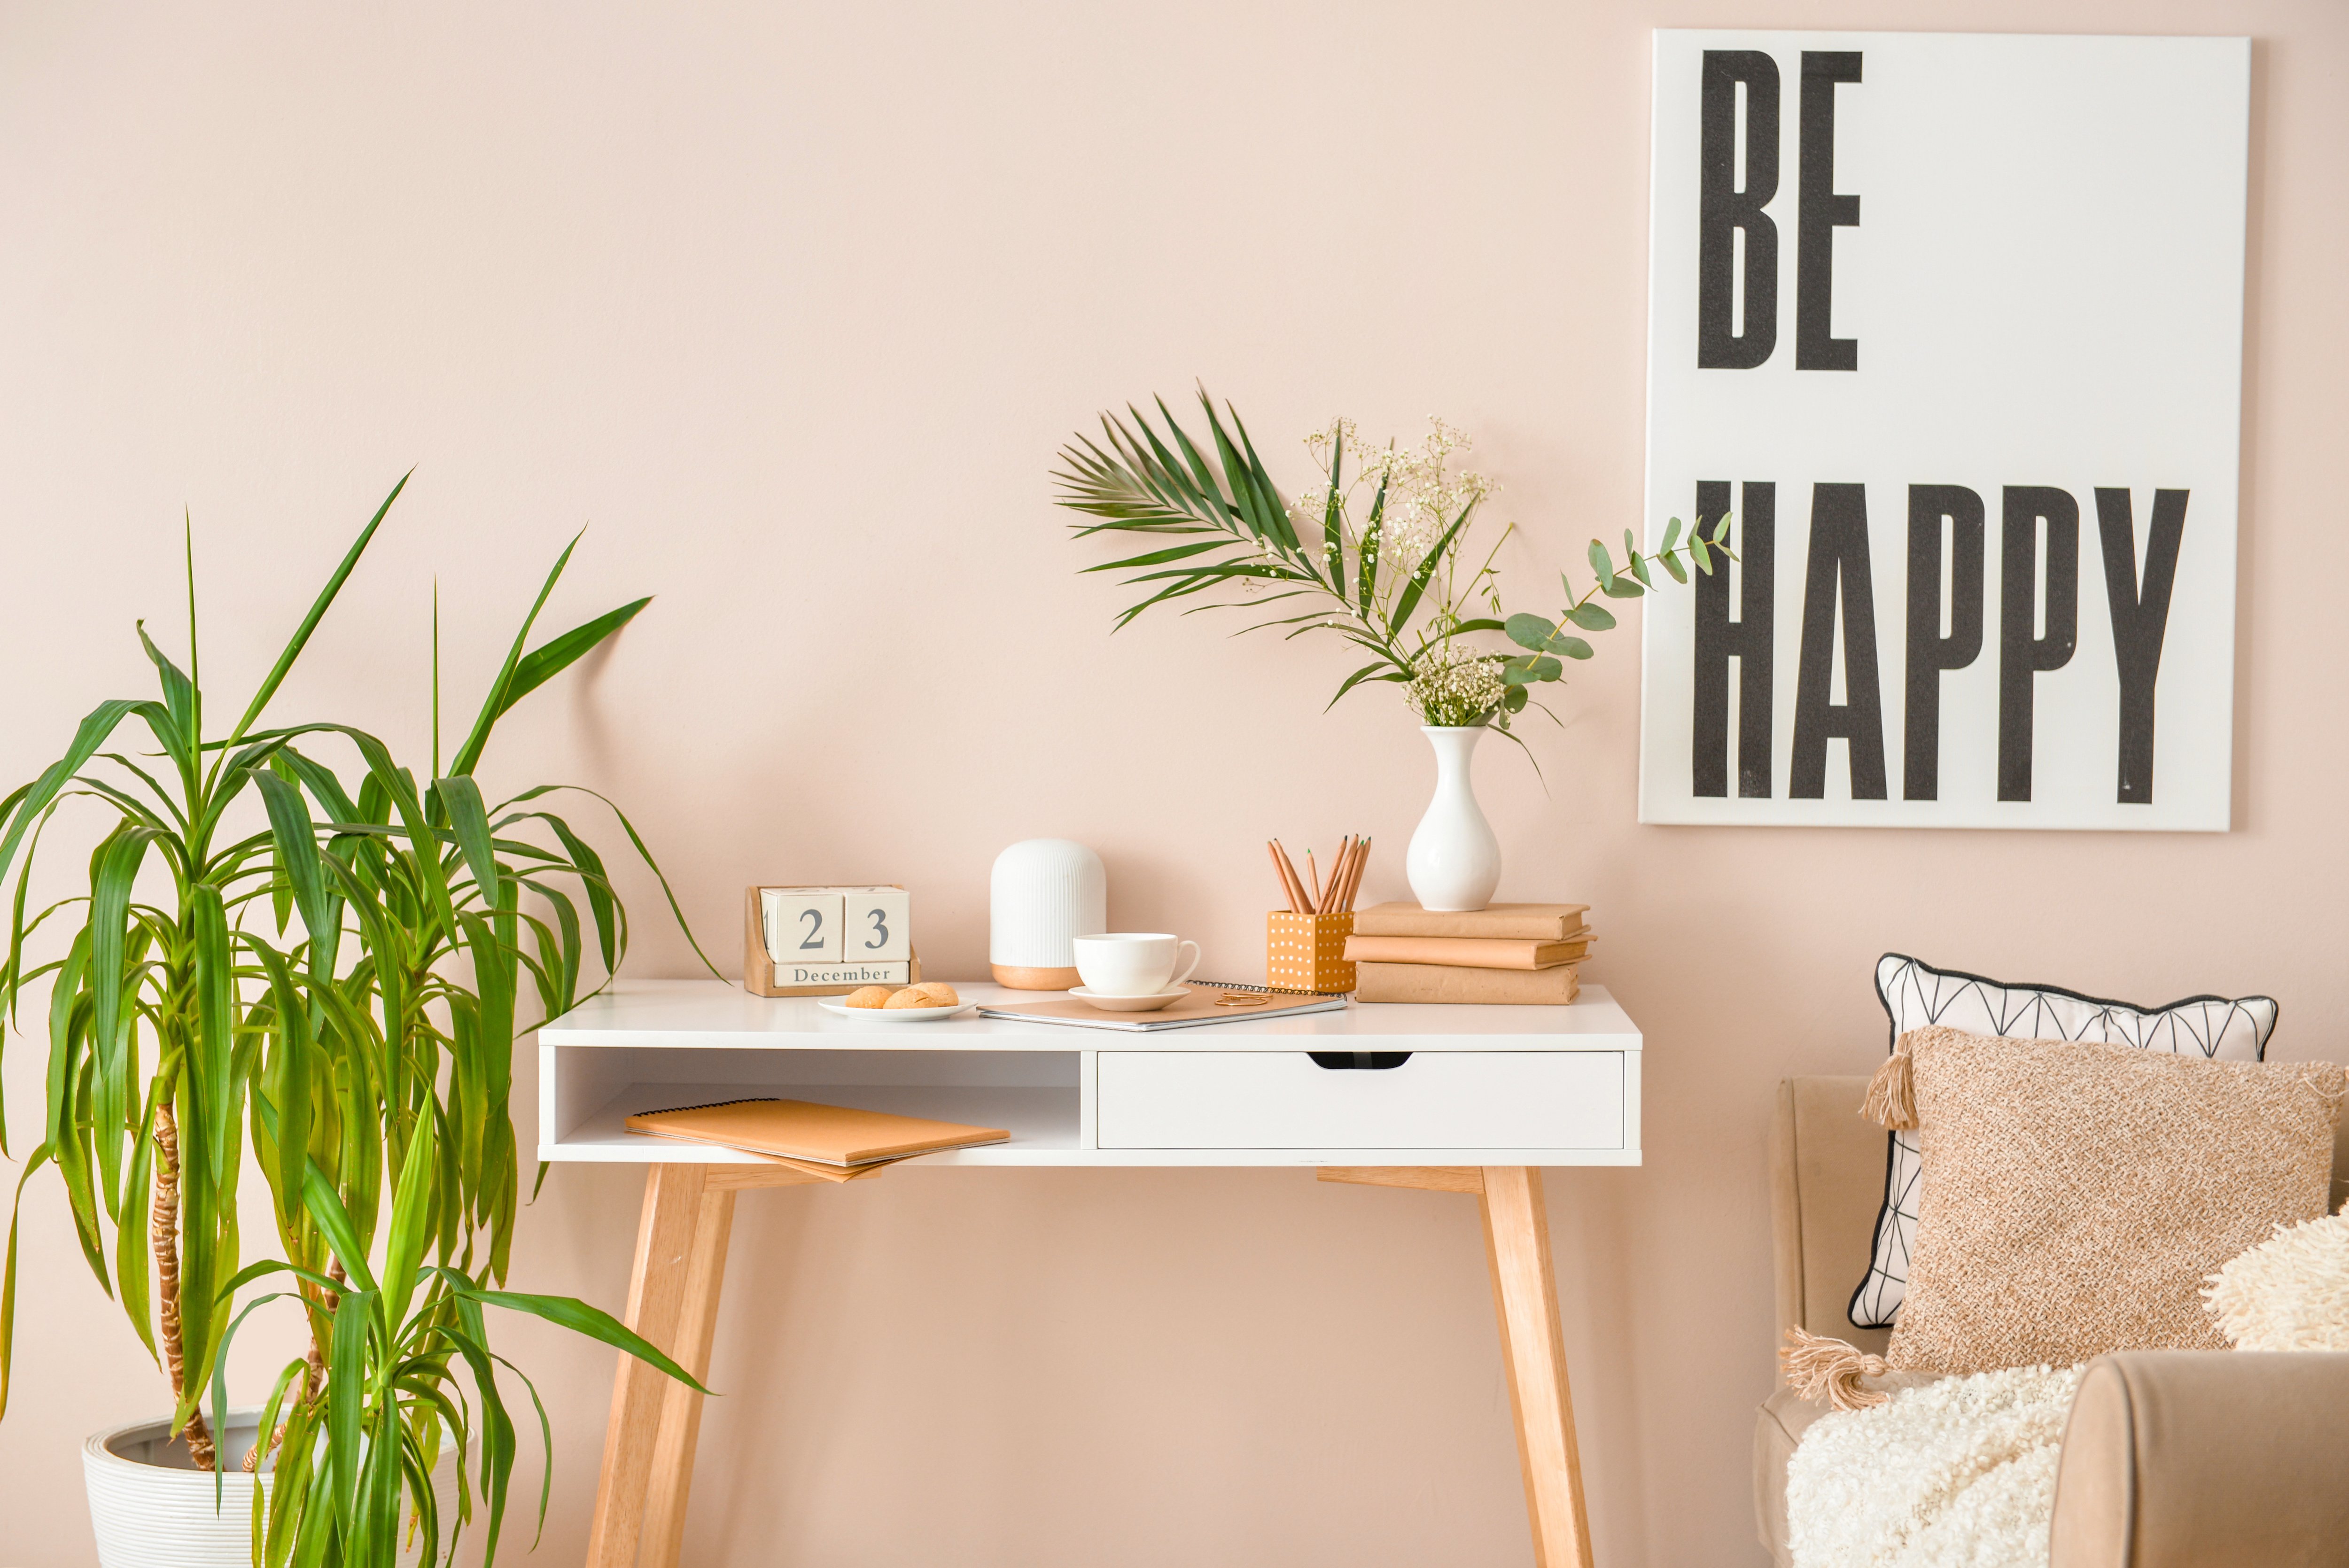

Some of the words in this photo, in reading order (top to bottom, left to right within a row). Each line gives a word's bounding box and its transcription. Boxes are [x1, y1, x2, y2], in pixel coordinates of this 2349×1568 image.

[1697, 49, 1863, 372] BE
[1692, 480, 2190, 805] HAPPY
[793, 967, 890, 982] December
